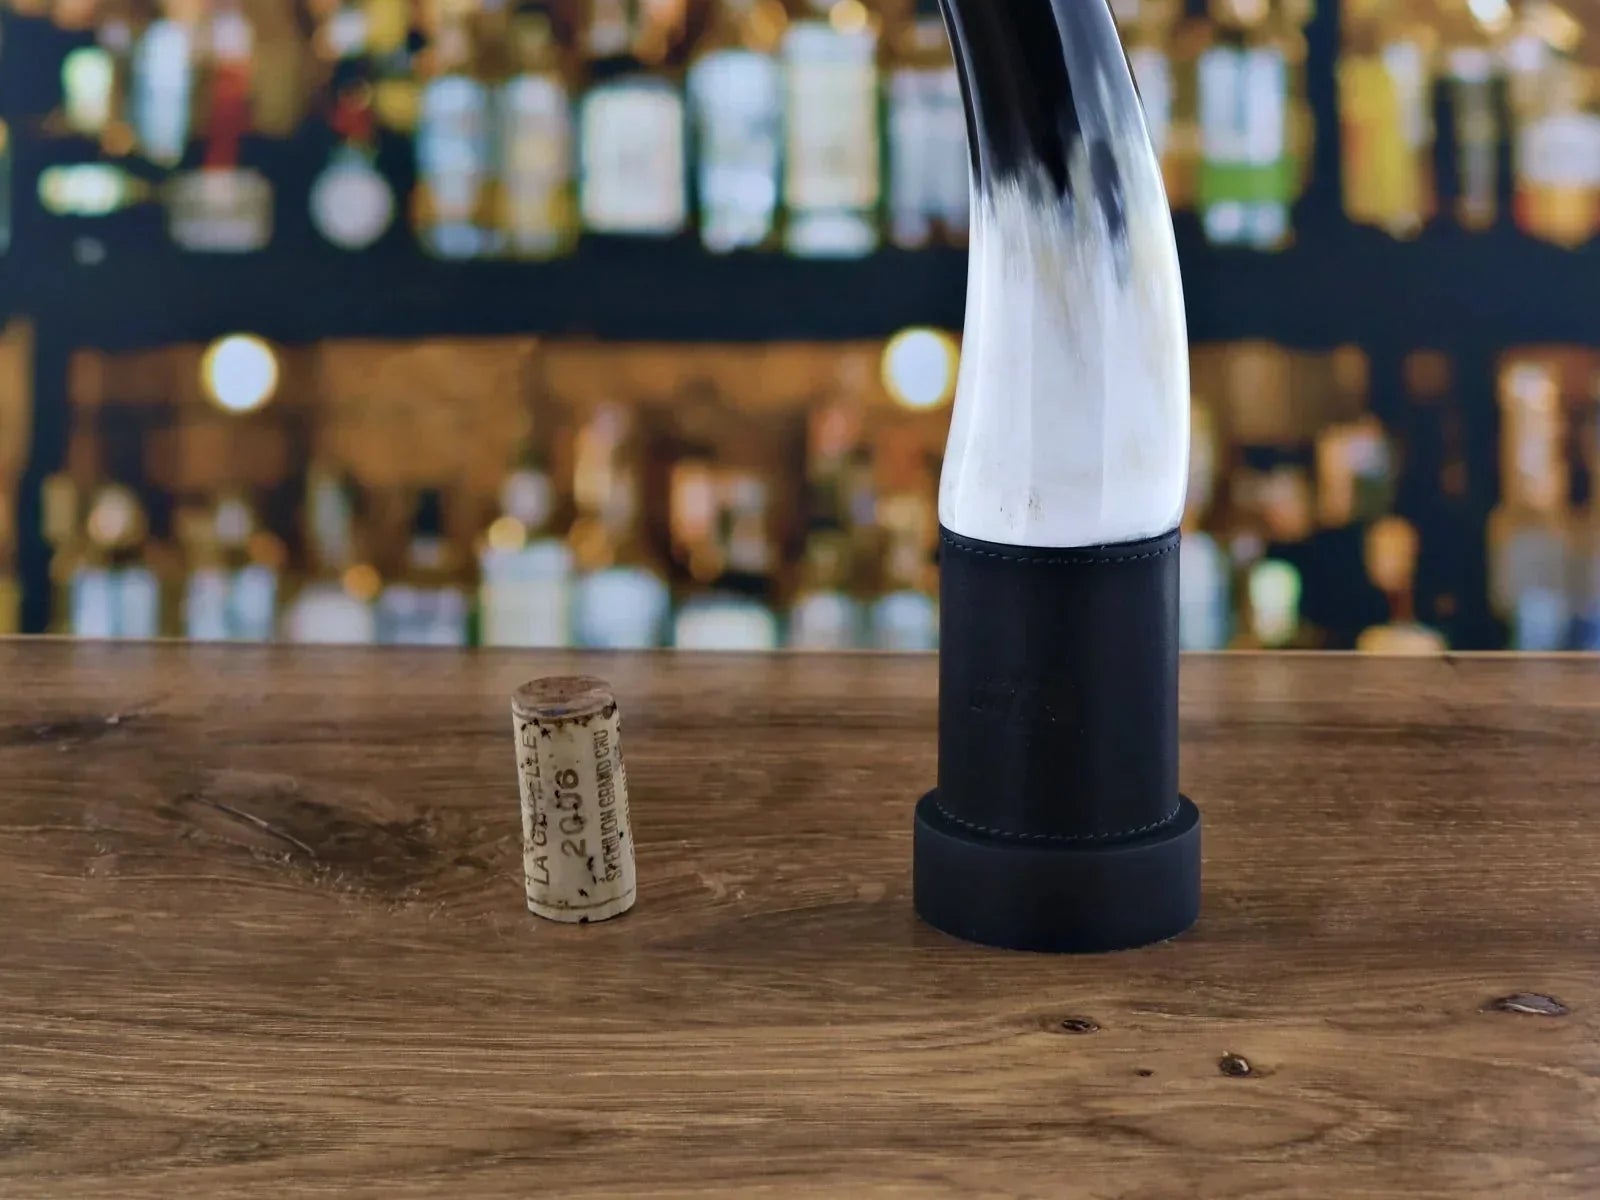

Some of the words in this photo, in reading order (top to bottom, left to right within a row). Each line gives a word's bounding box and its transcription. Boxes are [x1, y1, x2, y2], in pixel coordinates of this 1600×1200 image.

[594, 728, 610, 758] CRU
[596, 759, 616, 808] GRAND
[555, 768, 587, 858] 2006
[530, 854, 550, 886] LA
